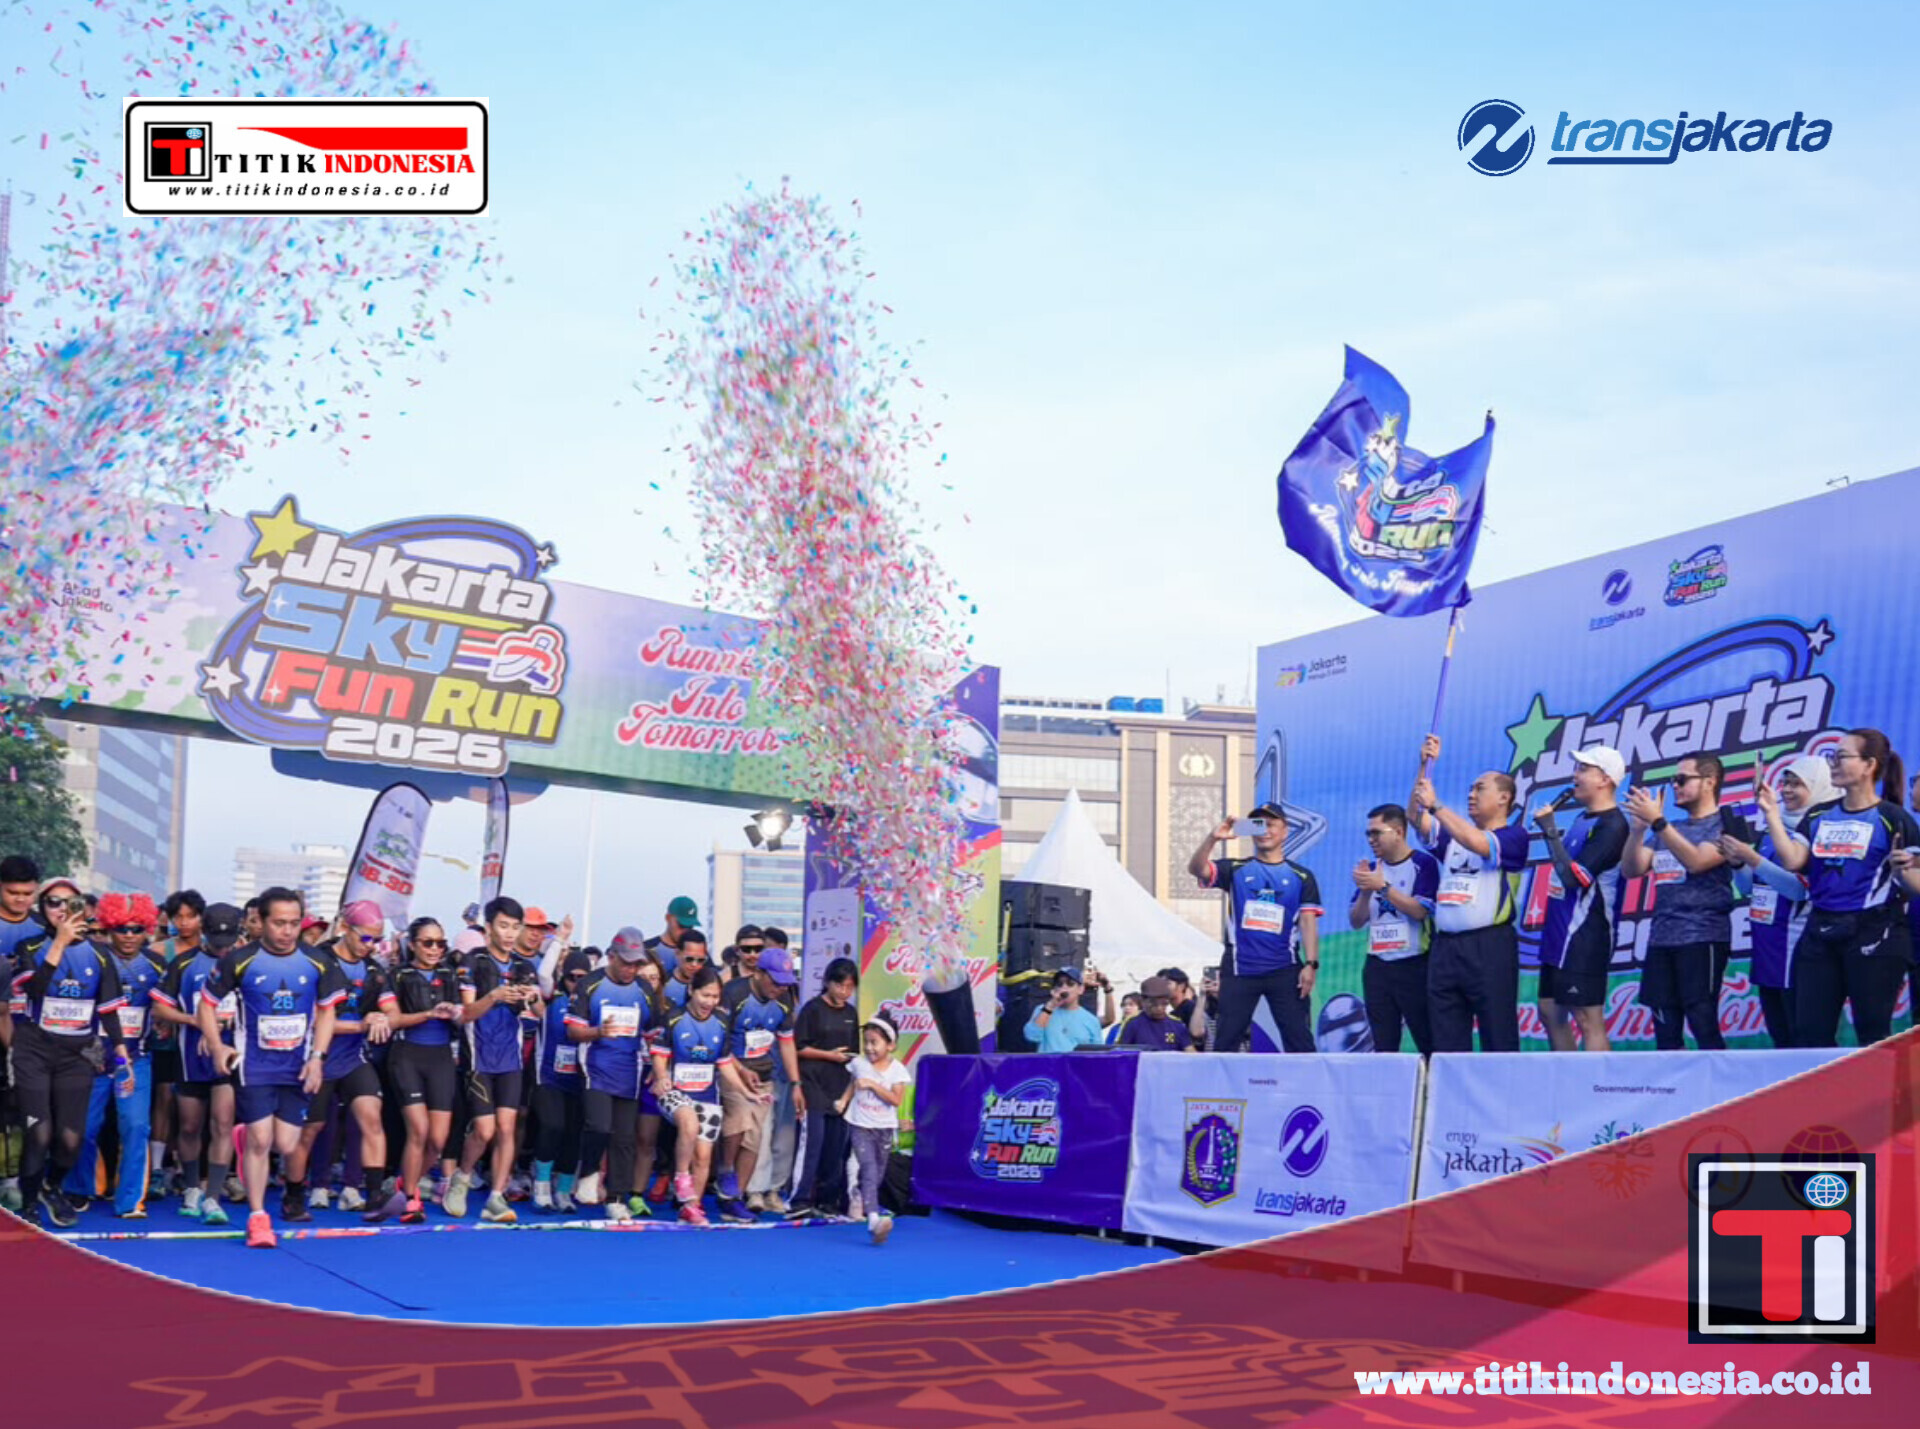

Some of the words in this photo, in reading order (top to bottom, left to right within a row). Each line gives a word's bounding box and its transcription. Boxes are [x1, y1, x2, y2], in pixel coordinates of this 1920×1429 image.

[280, 532, 550, 621] Jakarta
[254, 582, 461, 675] Sky
[260, 650, 415, 720] Fun
[421, 675, 562, 739] Run
[326, 717, 505, 770] 2026
[989, 1097, 1056, 1116] Jakarta
[983, 1118, 1032, 1144] Sky
[1446, 1131, 1479, 1148] enjoy
[985, 1143, 1022, 1162] Fun
[1020, 1143, 1057, 1164] Run
[997, 1164, 1041, 1178] 2026
[1254, 1188, 1346, 1217] transjakarta
